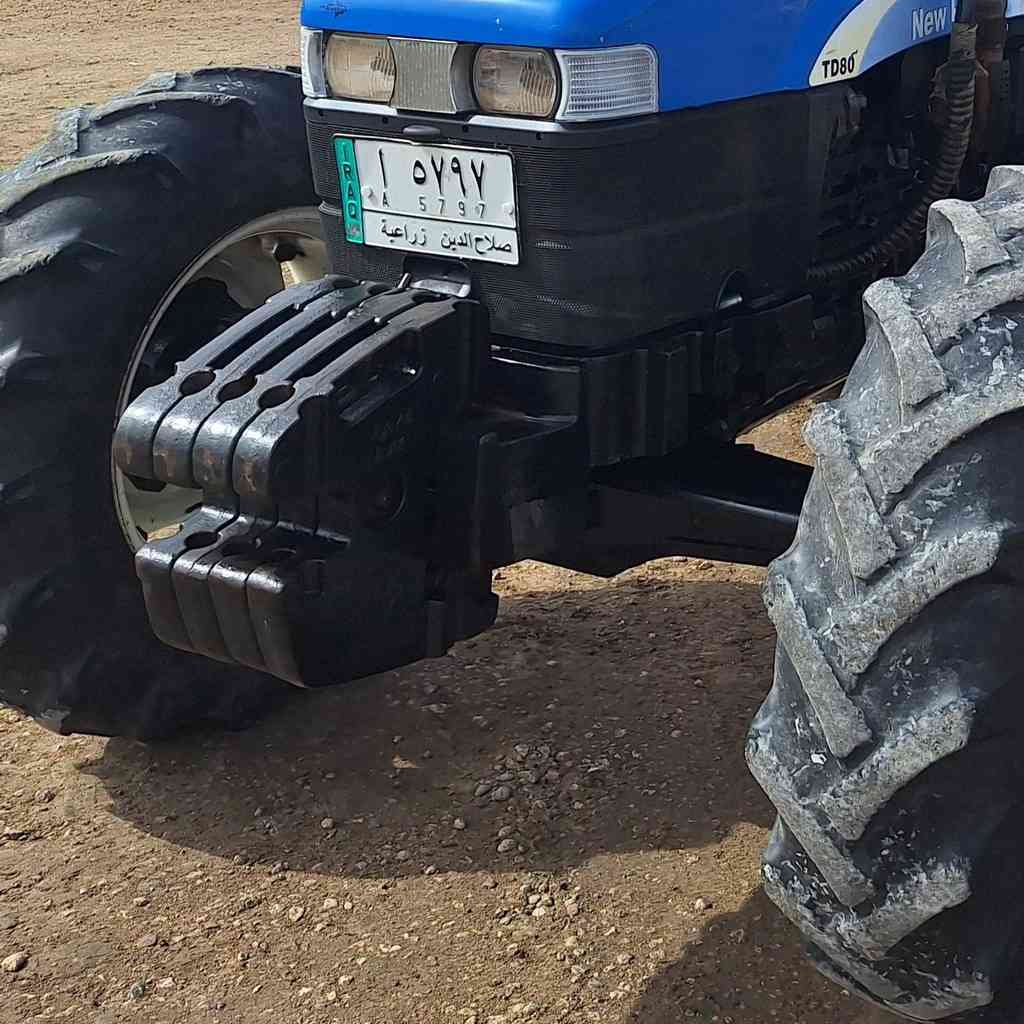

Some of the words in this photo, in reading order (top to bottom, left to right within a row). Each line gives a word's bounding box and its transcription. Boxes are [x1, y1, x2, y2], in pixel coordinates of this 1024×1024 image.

[911, 7, 947, 41] New
[822, 53, 857, 78] TD80
[340, 140, 358, 219] IRAQ
[412, 154, 486, 200] ٥٧٩٧
[381, 191, 390, 208] A
[380, 219, 427, 246] زراعية
[440, 231, 473, 251] الدين
[474, 234, 513, 254] صلاح
